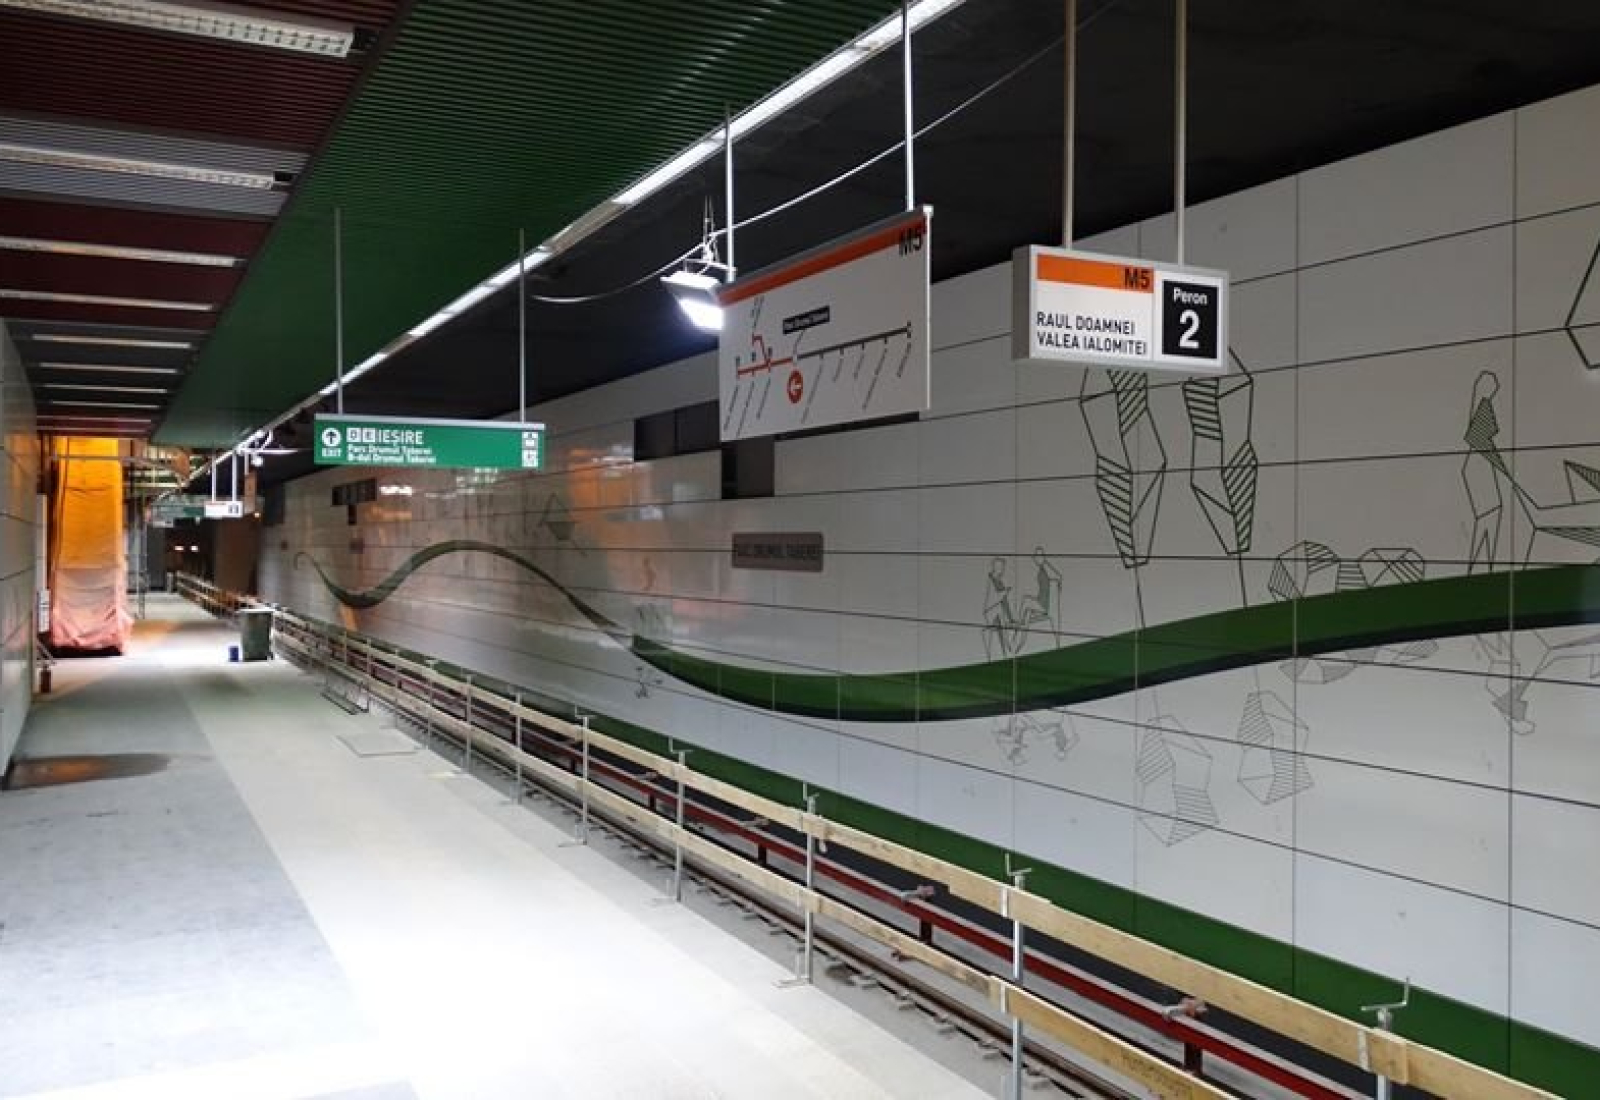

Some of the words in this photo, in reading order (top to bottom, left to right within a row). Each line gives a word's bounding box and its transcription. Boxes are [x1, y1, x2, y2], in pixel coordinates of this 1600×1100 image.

[899, 228, 922, 256] M5
[1124, 267, 1150, 291] M5
[1173, 287, 1208, 305] Peron
[1036, 311, 1072, 329] RAUL
[1075, 315, 1136, 336] DOAMNEI
[1178, 309, 1201, 350] 2
[1036, 331, 1080, 350] VALEA
[1083, 336, 1147, 356] IALOMITEI
